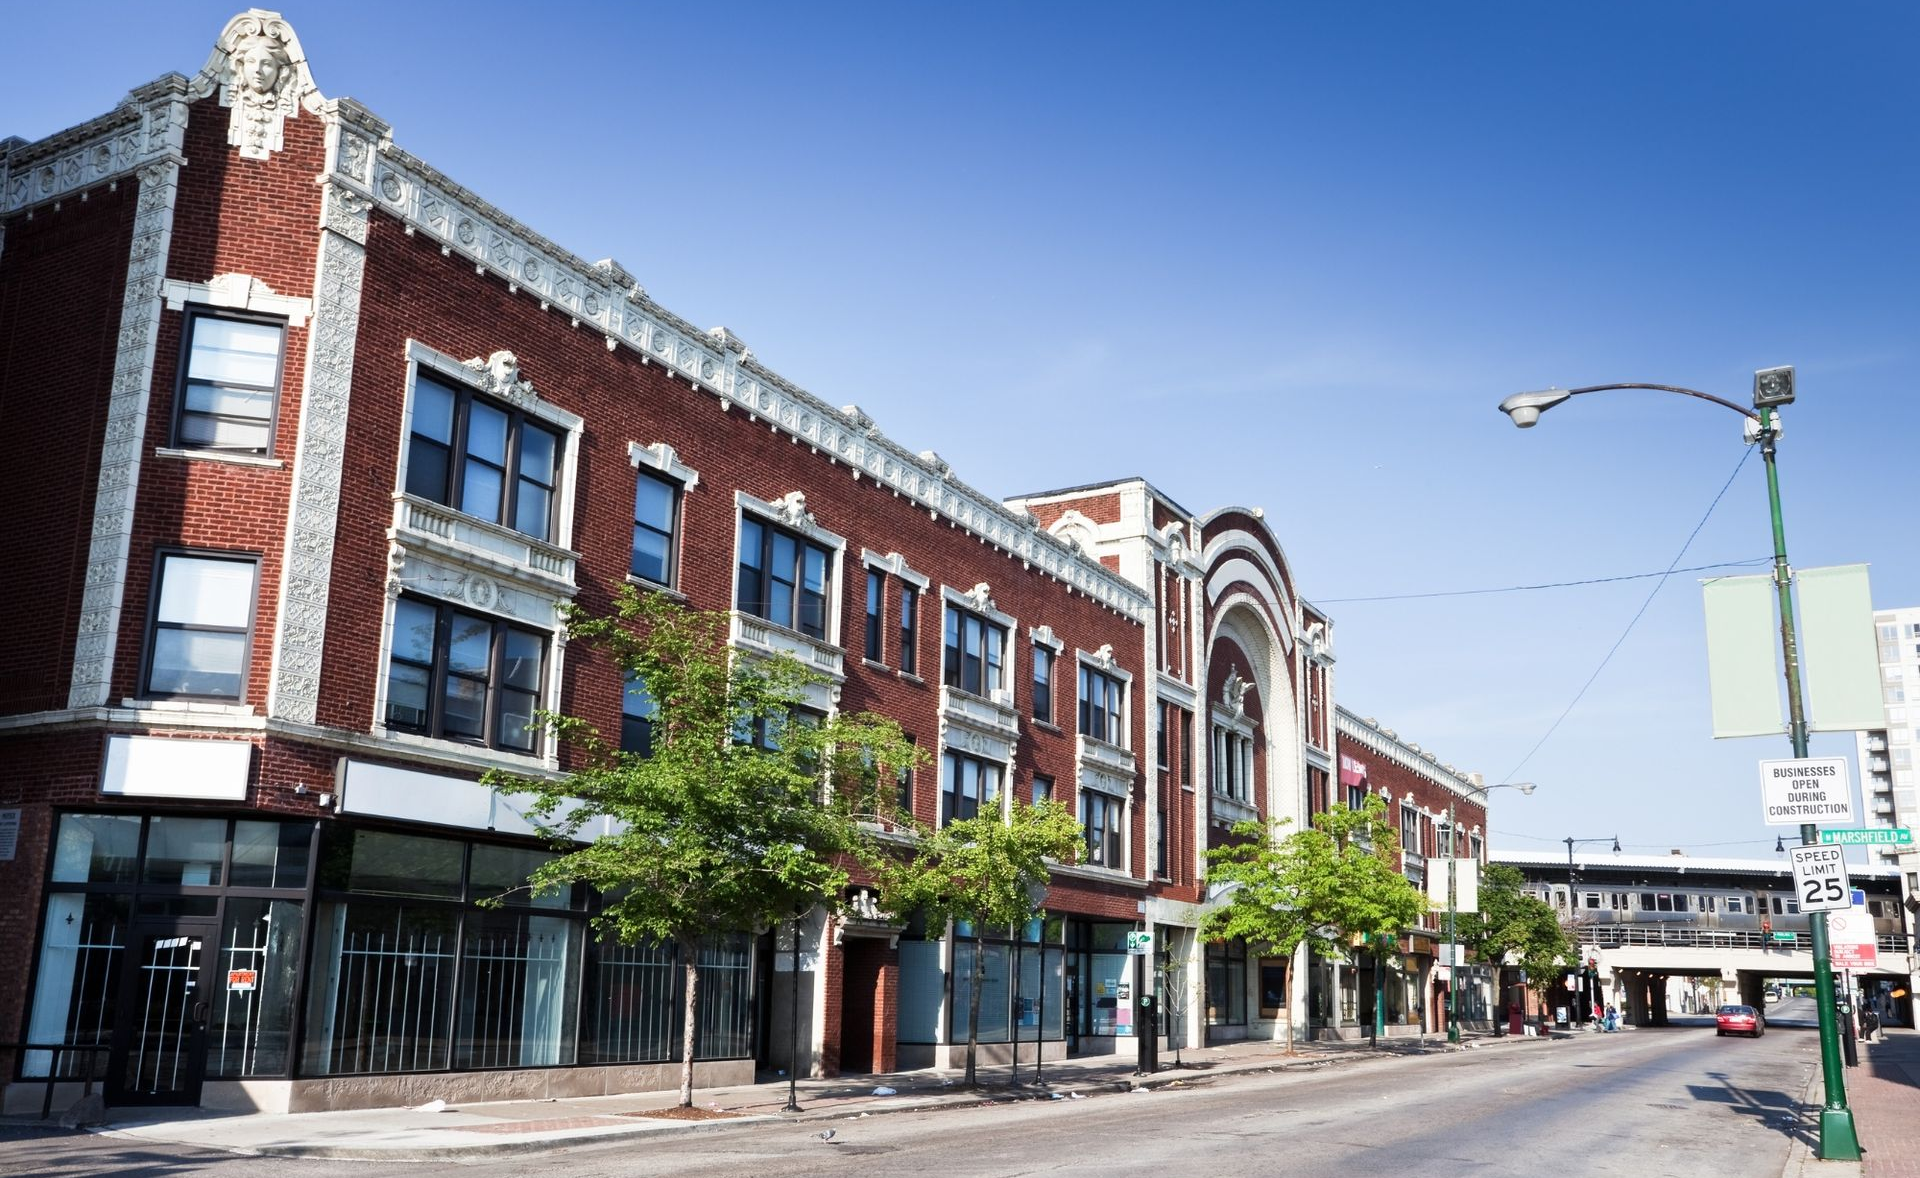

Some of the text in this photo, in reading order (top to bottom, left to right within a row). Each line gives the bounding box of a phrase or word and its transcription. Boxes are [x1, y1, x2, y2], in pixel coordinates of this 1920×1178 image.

[1773, 766, 1836, 778] BUSINESSES
[1792, 779, 1819, 790] OPEN
[1787, 791, 1827, 803] DURING
[1769, 803, 1848, 816] CONSTRUCTION
[1832, 831, 1898, 843] MARSHFIELD
[1795, 850, 1840, 863] SPEED
[1802, 863, 1837, 876] LIMIT
[1803, 878, 1844, 904] 25
